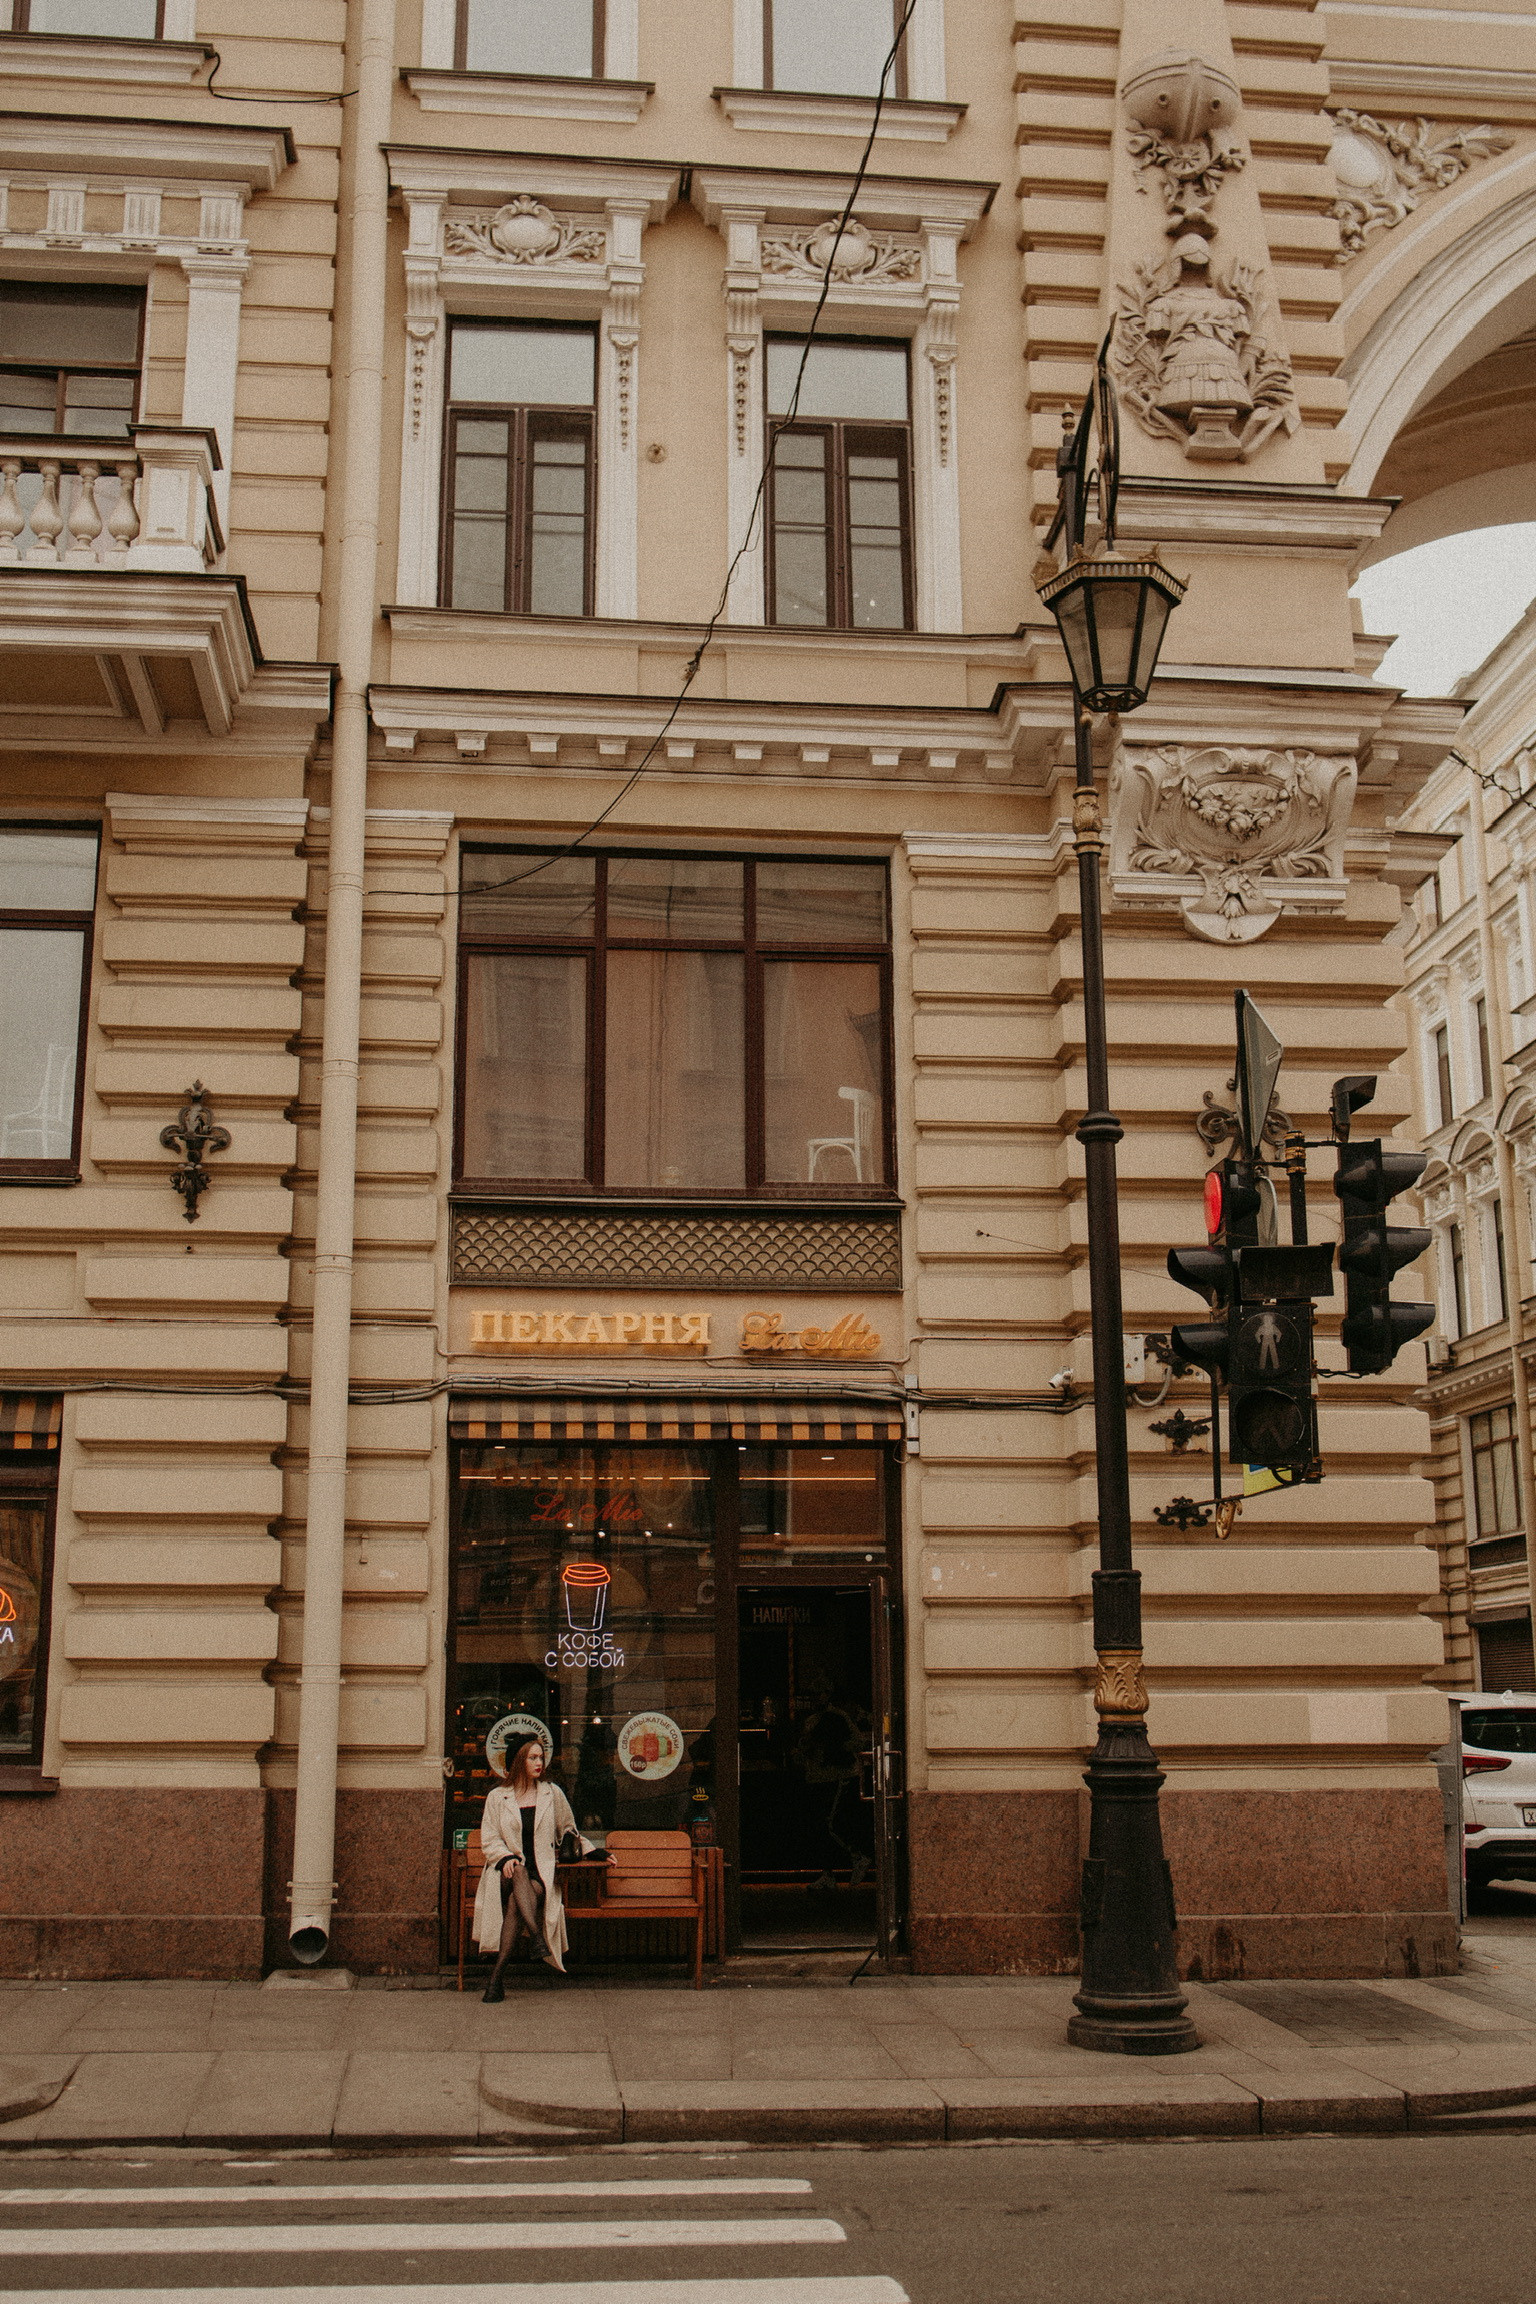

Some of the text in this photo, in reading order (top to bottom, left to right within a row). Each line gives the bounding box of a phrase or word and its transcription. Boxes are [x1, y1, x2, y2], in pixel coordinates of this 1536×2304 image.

[471, 1310, 712, 1344] ПЕКАРНЯ
[738, 1311, 790, 1350] La
[530, 1492, 574, 1522] La
[558, 1633, 615, 1650] КОФЕ
[545, 1648, 625, 1668] С СОБОЙ
[490, 1717, 519, 1745] ГОРЯЧИЕ
[622, 1717, 680, 1750] СВЕЖЕВЫЖАТЫЕ СОКИ
